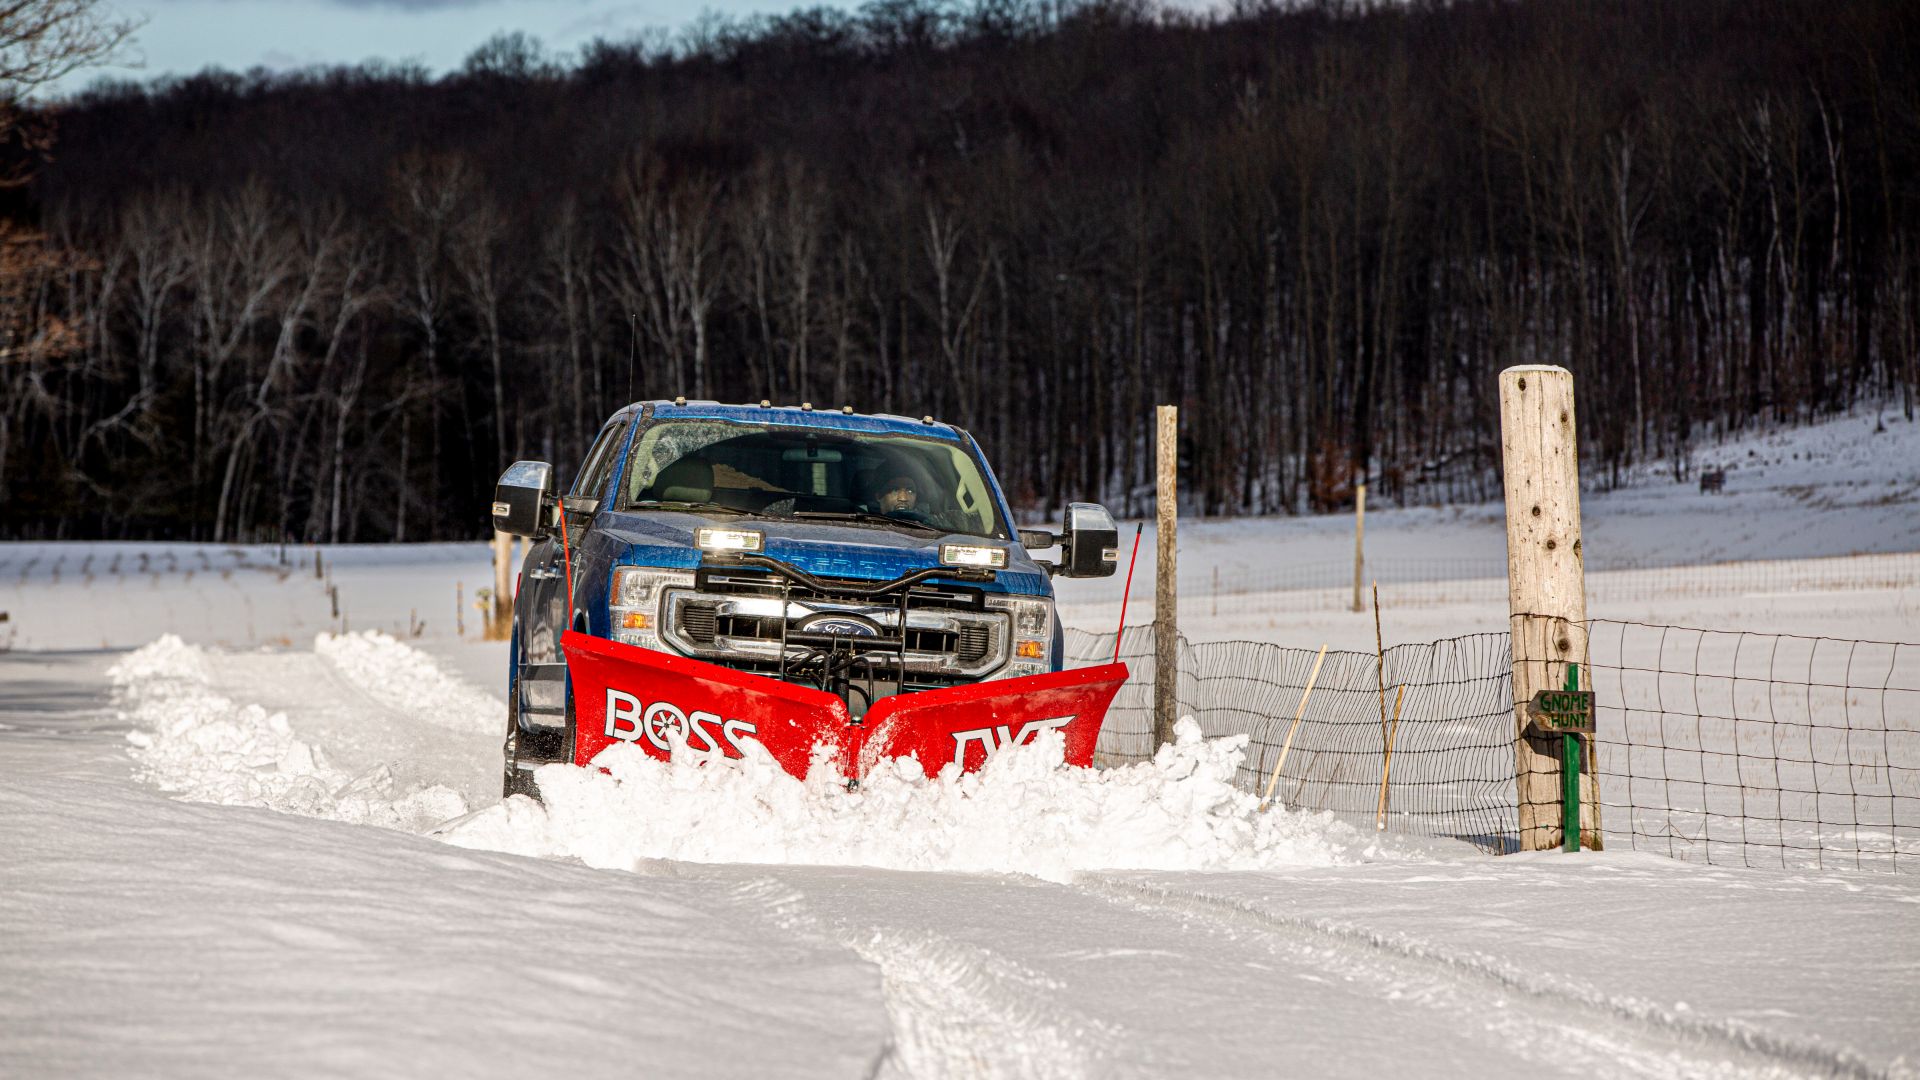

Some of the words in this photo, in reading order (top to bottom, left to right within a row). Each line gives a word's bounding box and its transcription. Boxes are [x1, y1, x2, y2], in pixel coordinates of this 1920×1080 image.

[1540, 692, 1589, 711] GNOME
[604, 687, 757, 762] BOSS
[1551, 712, 1587, 728] HUNT
